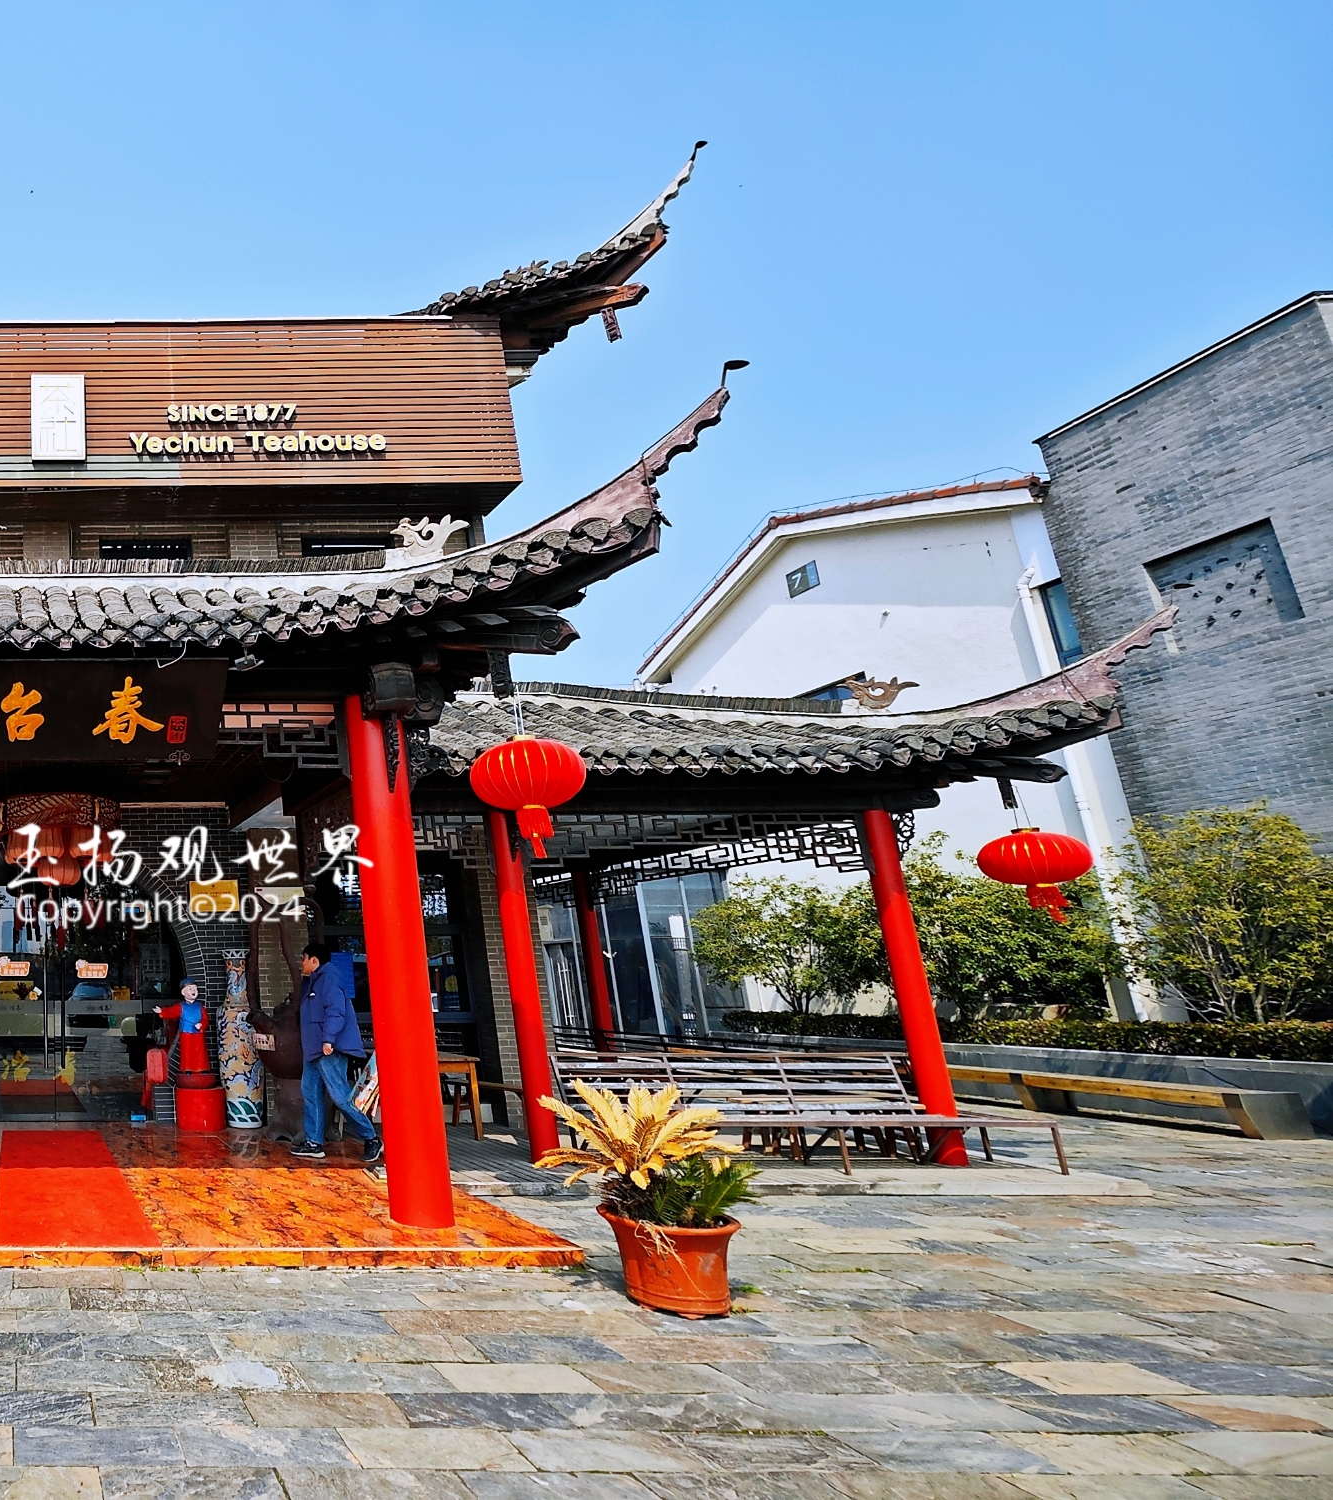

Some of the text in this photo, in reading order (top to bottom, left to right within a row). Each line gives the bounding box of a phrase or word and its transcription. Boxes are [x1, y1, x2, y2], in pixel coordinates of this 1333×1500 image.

[39, 382, 78, 453] 茶社
[167, 403, 297, 423] SINCE 1877
[129, 431, 387, 454] Yechun Teahouse
[791, 572, 802, 589] 7
